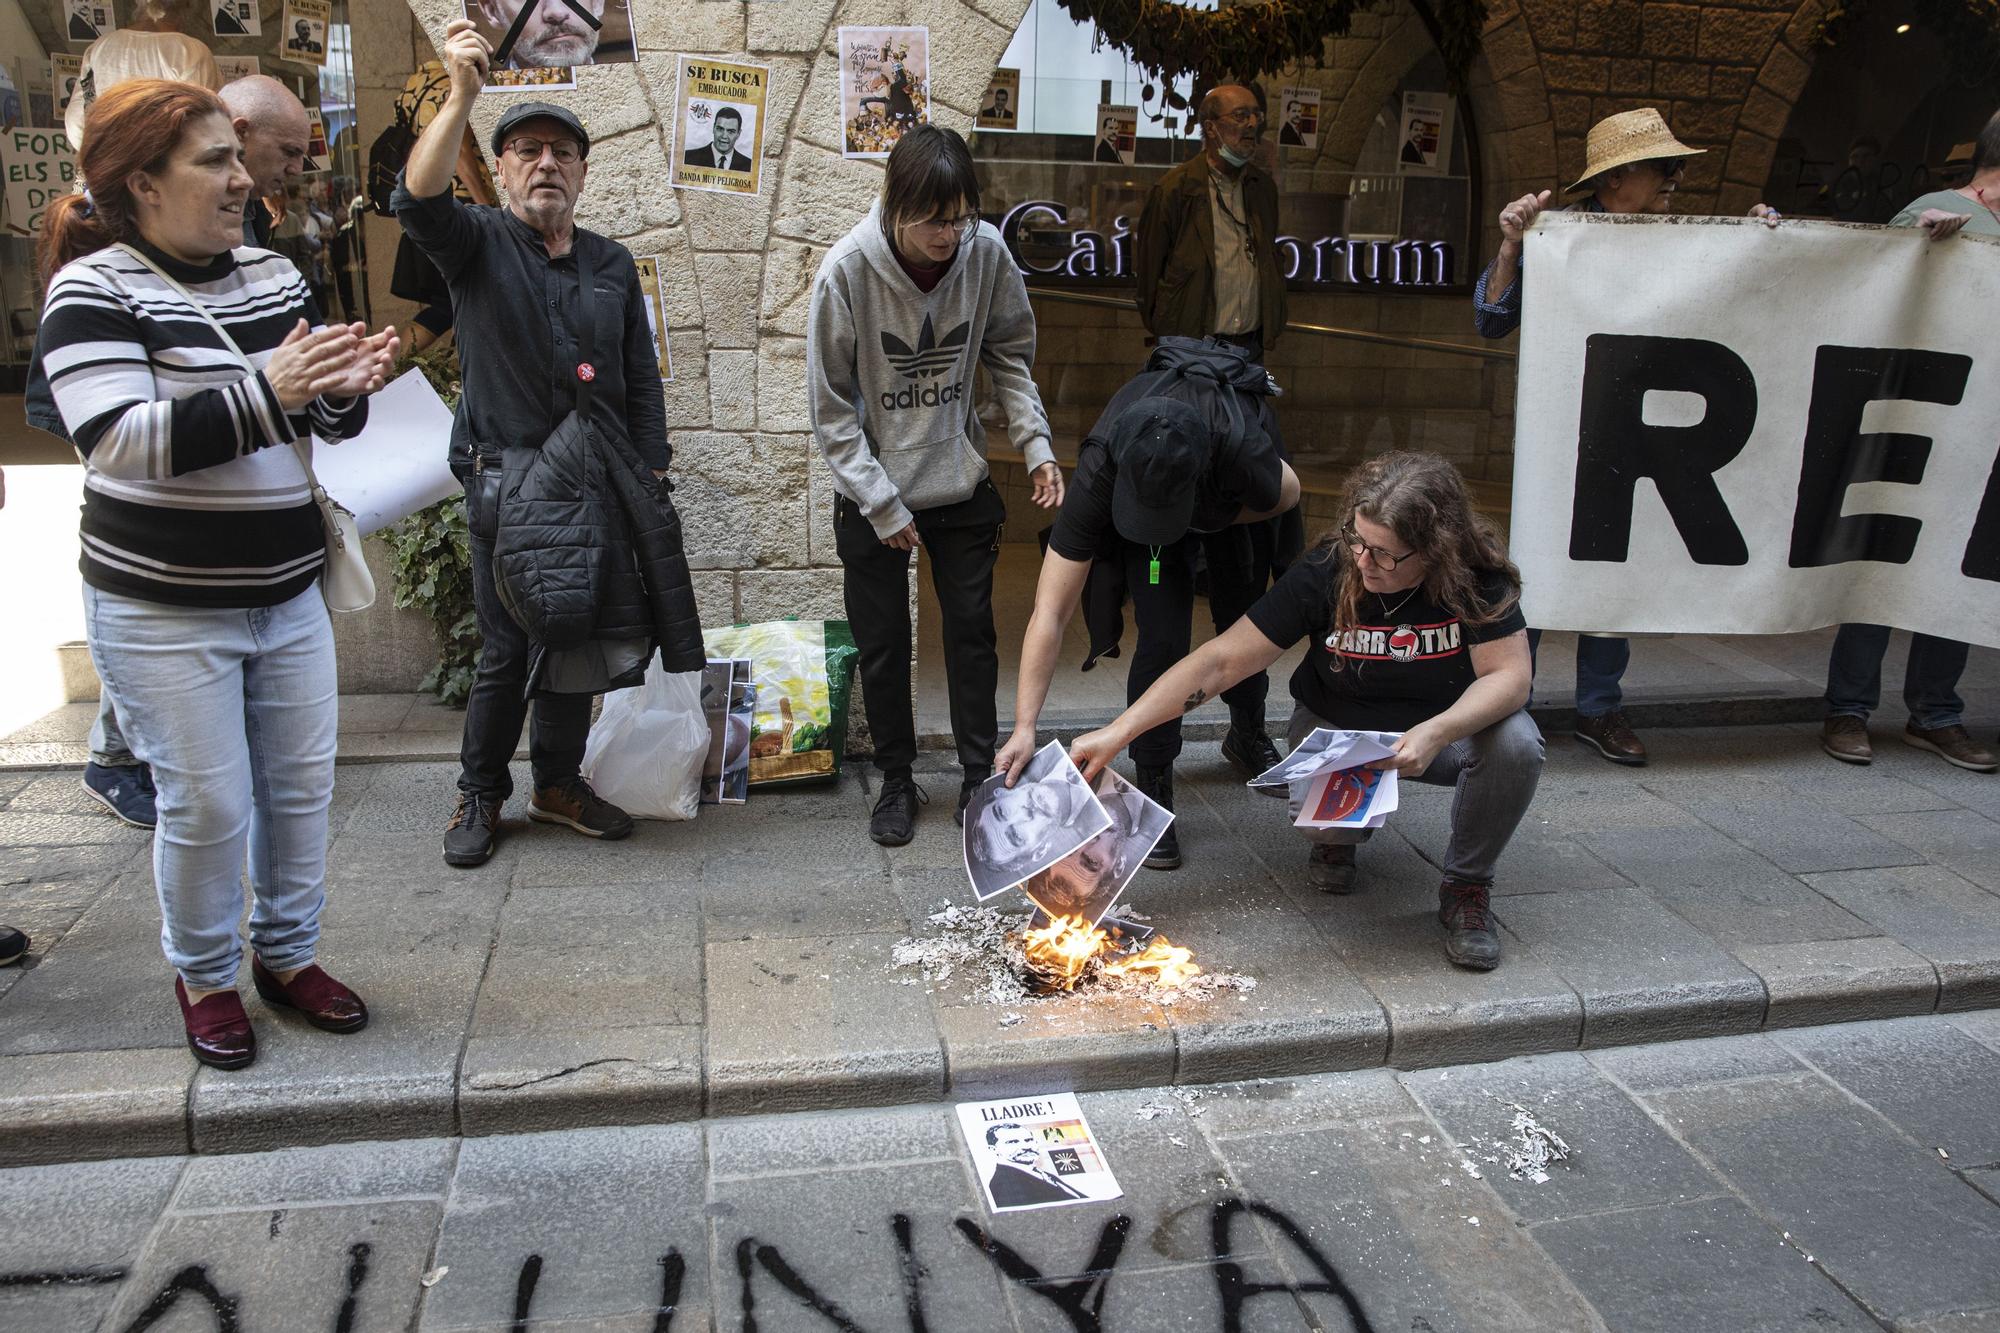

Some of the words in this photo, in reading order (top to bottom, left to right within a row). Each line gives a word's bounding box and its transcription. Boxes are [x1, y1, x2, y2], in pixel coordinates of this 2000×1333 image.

[687, 65, 707, 79] SE
[711, 68, 760, 87] BUSCA
[698, 82, 748, 99] EMBAUCADOR
[14, 132, 76, 155] FOR
[9, 162, 48, 182] ELS
[679, 171, 701, 181] BANDA
[702, 174, 717, 184] MUY
[717, 176, 752, 189] PELIGROSA
[881, 382, 962, 411] adidas
[981, 1102, 1047, 1122] LLADRE
